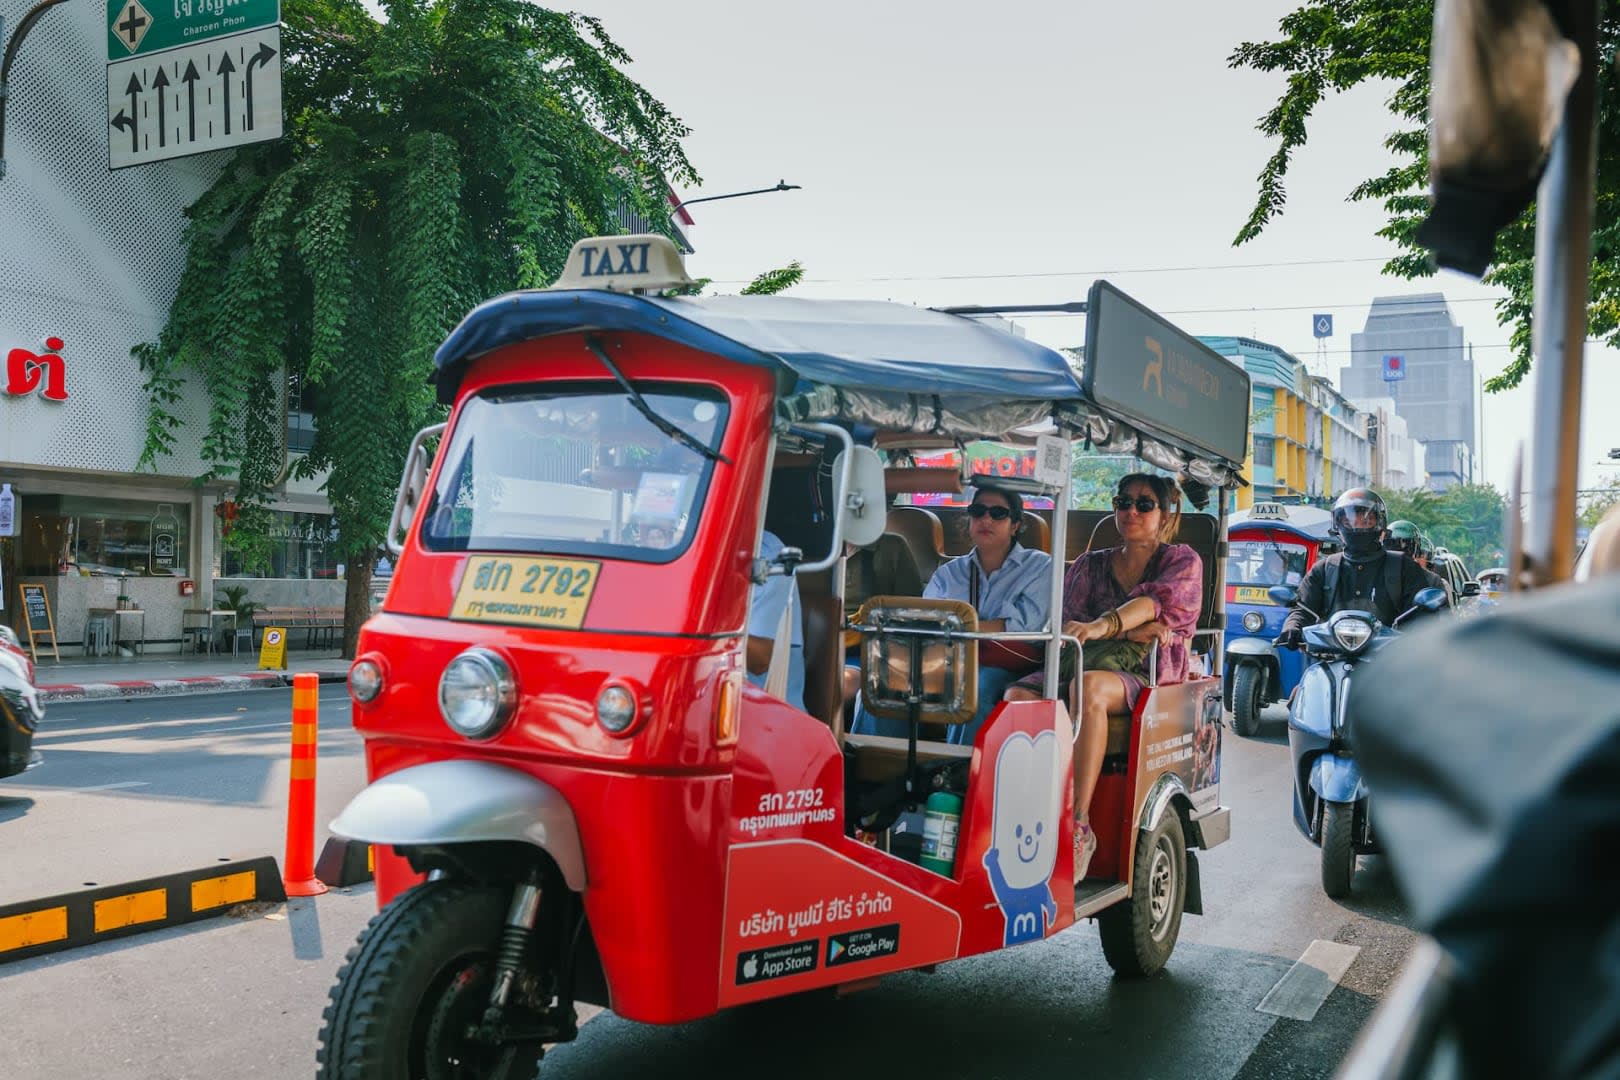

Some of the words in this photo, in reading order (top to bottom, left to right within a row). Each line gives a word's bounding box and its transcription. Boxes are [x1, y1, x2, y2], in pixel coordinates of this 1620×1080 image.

[183, 22, 220, 36] Charoen
[223, 16, 245, 27] Phon
[579, 242, 651, 277] TAXI
[1255, 505, 1279, 514] TAXI
[520, 563, 591, 597] 2792
[758, 792, 783, 812] สก
[785, 788, 824, 810] 2792
[740, 808, 836, 837] กรุงเทพมหานคร
[739, 909, 784, 938] บริษัท
[788, 899, 823, 937] มูฟมี
[856, 891, 892, 917] จำกัด
[763, 948, 794, 960] Download
[803, 944, 813, 952] the
[847, 940, 877, 957] Google
[878, 938, 895, 951] Play
[762, 961, 784, 977] App
[785, 956, 812, 972] Store
